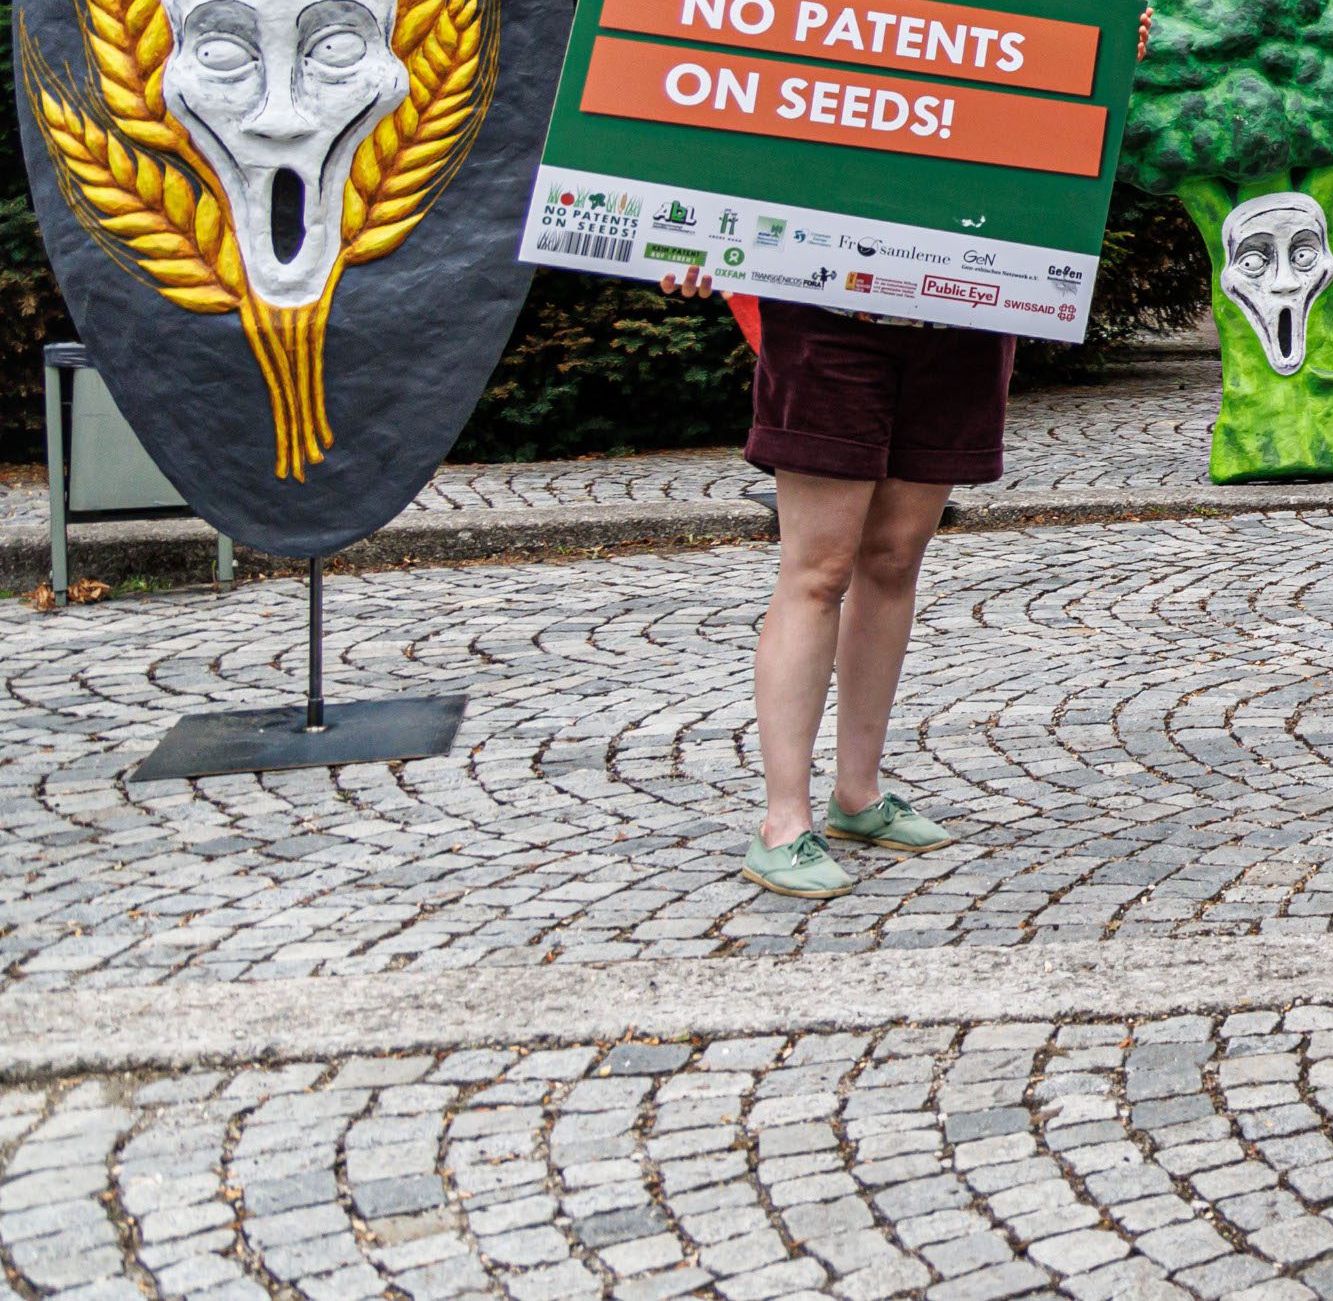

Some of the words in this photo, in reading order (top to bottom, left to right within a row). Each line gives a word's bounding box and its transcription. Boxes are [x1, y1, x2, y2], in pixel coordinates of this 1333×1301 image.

[795, 0, 1025, 72] PATENTS
[665, 63, 760, 113] ON
[776, 77, 954, 139] SEEDS!
[542, 216, 566, 228] ON
[578, 222, 637, 239] SEEDS!
[544, 205, 566, 217] NO
[573, 209, 639, 228] PATENTS
[714, 268, 746, 280] OXFAM
[927, 280, 966, 298] Public
[969, 287, 994, 302] Eye
[1004, 299, 1055, 315] SWISSAID
